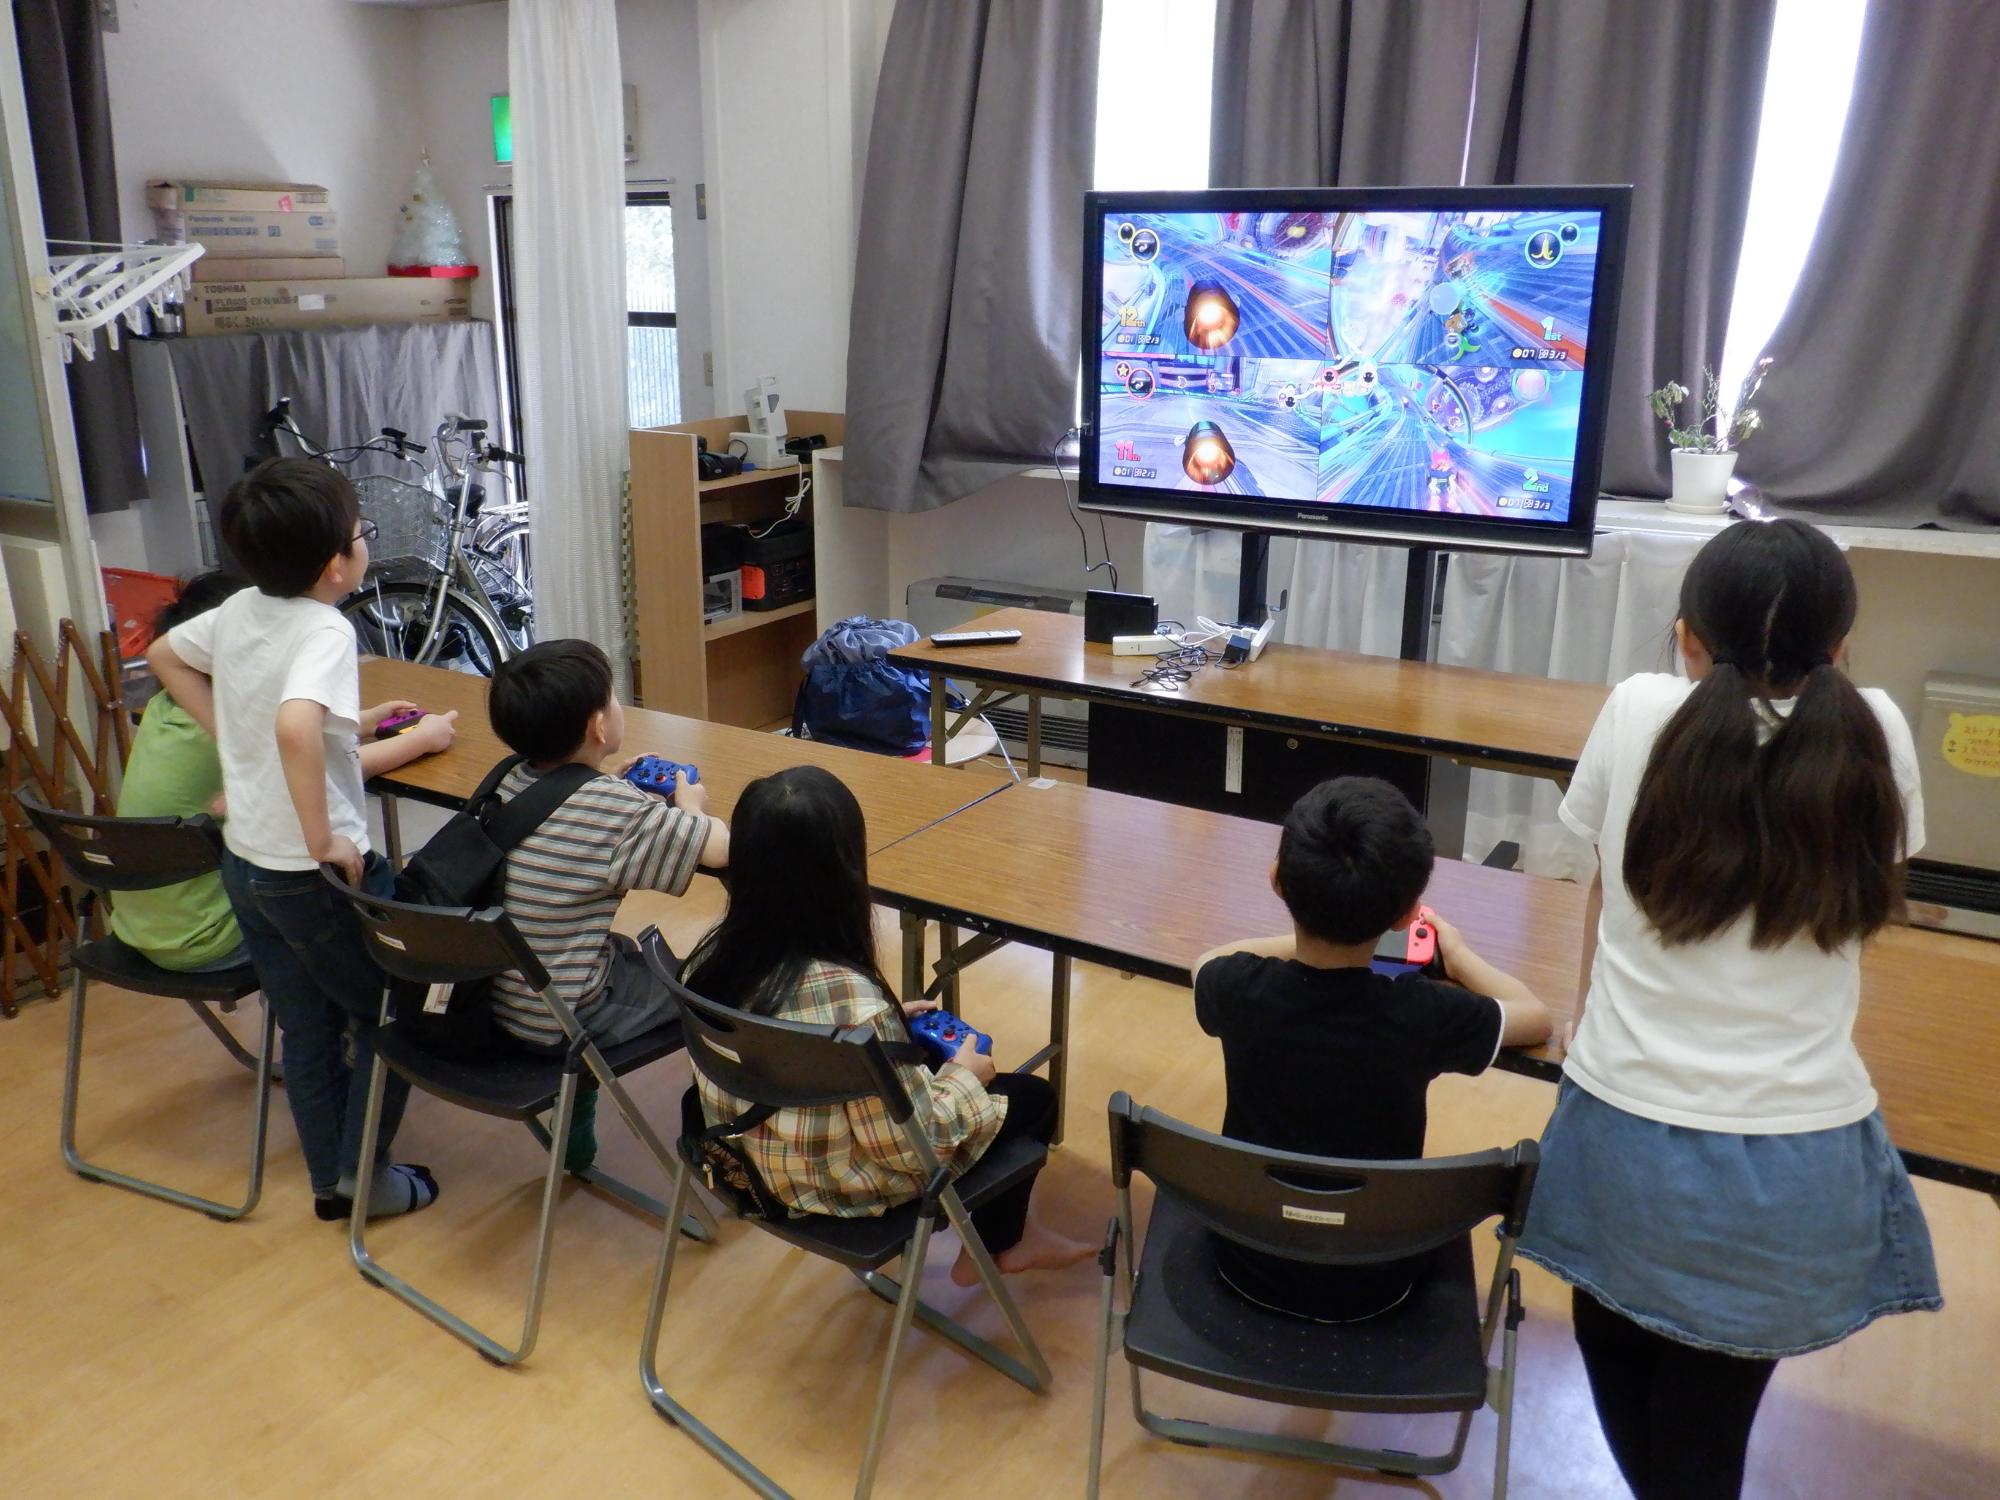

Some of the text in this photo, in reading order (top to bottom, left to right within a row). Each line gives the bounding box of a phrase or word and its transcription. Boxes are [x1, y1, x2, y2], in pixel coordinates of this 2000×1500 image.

[204, 285, 247, 294] TOSHIBA
[1119, 306, 1146, 328] 12th
[1541, 316, 1563, 341] 1st
[1549, 350, 1566, 360] 3/3
[1522, 468, 1550, 493] 2nd
[1533, 500, 1550, 510] 3/3
